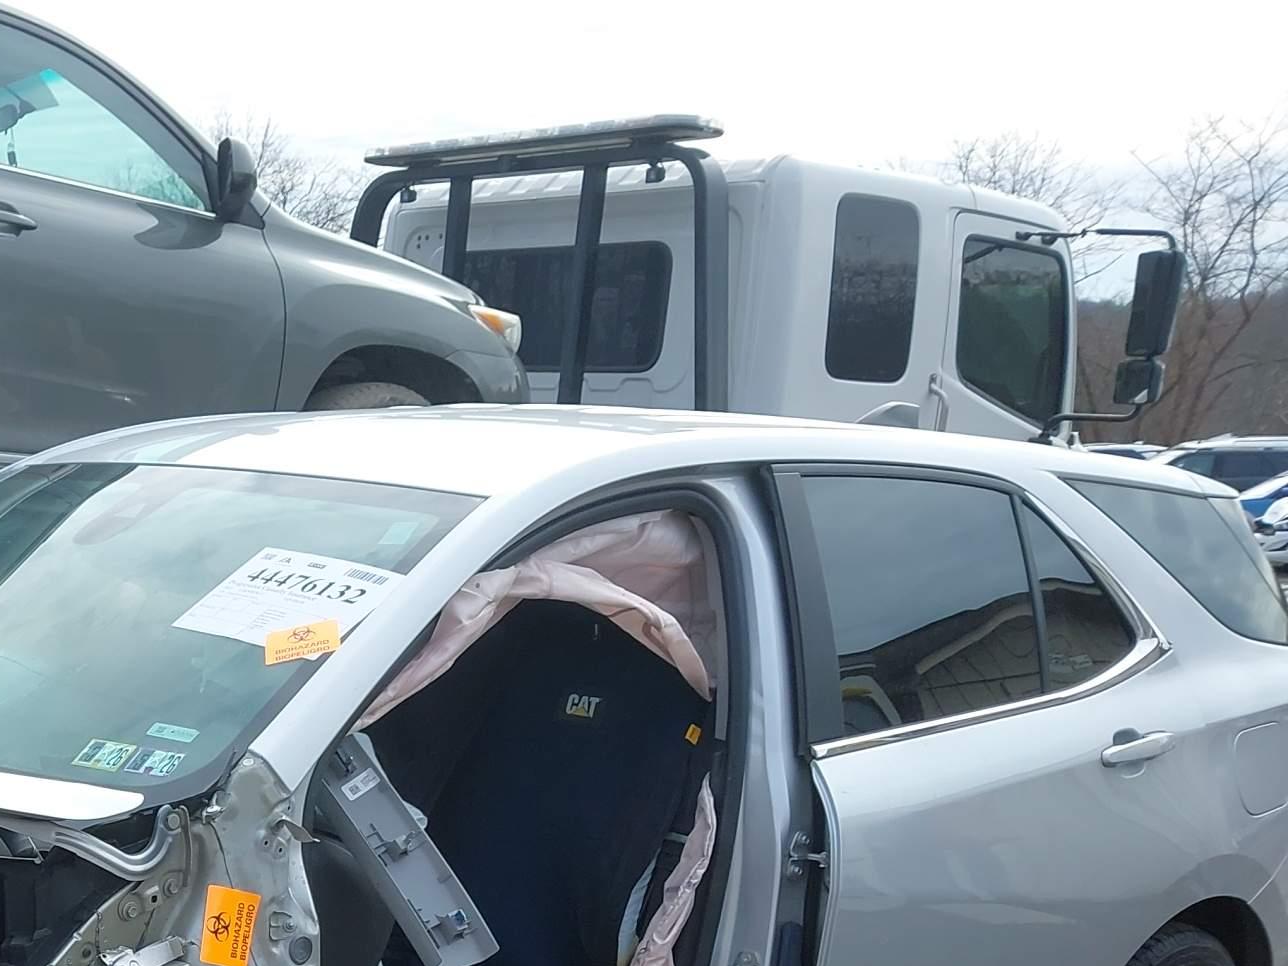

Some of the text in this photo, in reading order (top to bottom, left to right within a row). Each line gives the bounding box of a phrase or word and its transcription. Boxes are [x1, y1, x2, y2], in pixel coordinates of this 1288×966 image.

[247, 567, 367, 605] 44476132
[274, 639, 330, 656] BIOHAZARD
[274, 645, 331, 662] BIOPELIGRO
[565, 693, 600, 718] CAT
[230, 902, 245, 959] BIOHAZARD
[239, 904, 256, 961] BIOPELIGRO
